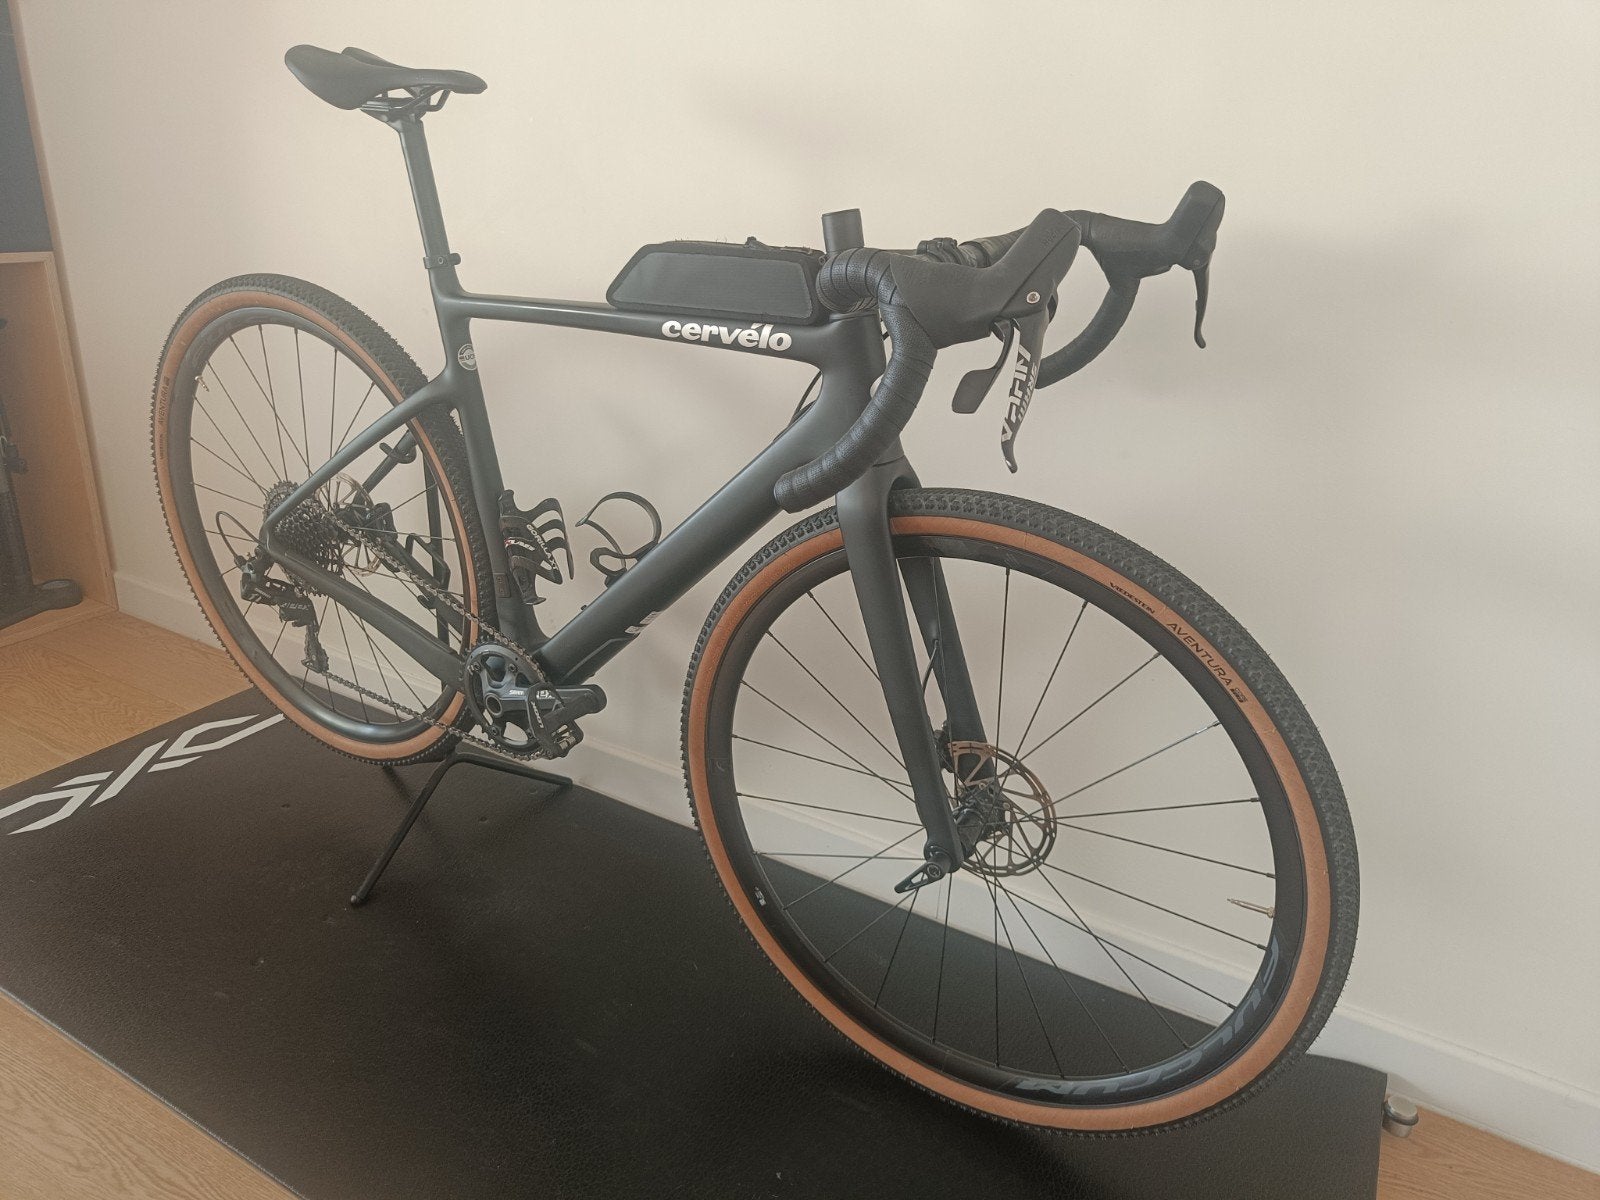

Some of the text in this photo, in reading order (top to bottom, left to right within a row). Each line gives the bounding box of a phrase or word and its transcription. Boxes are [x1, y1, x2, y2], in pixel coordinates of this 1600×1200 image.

[661, 320, 793, 351] cervélo
[157, 384, 169, 425] AVENTURA
[526, 523, 553, 559] GORILLA
[1166, 622, 1233, 686] AVENTURA
[1014, 934, 1280, 1095] FULCRUM
